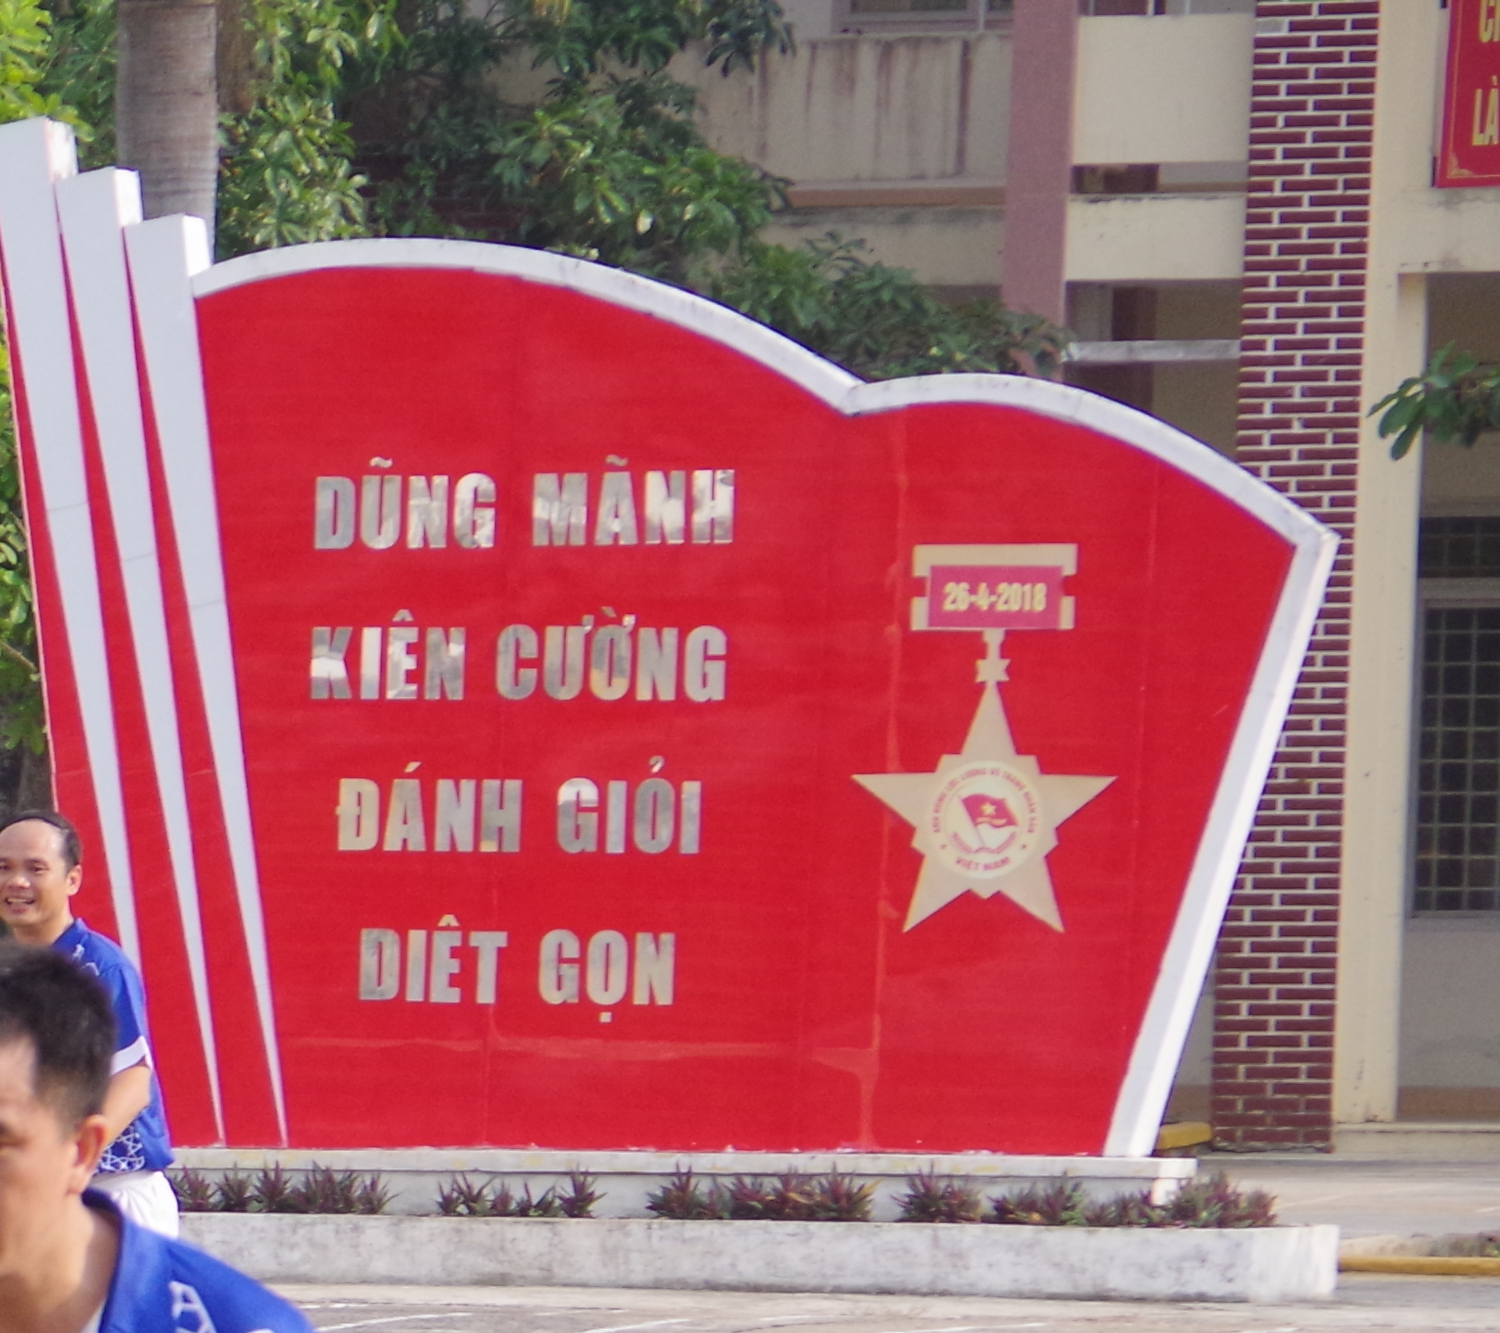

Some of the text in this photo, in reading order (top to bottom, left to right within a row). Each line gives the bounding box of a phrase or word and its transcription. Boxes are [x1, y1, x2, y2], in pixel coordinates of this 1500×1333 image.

[313, 454, 736, 551] DŨNG MÃNH
[942, 581, 1048, 613] 26-4-2018
[309, 606, 729, 703] KIÊN CƯỜNG
[335, 755, 703, 855] ĐÁNH GIỎI
[537, 928, 676, 1023] GỌN
